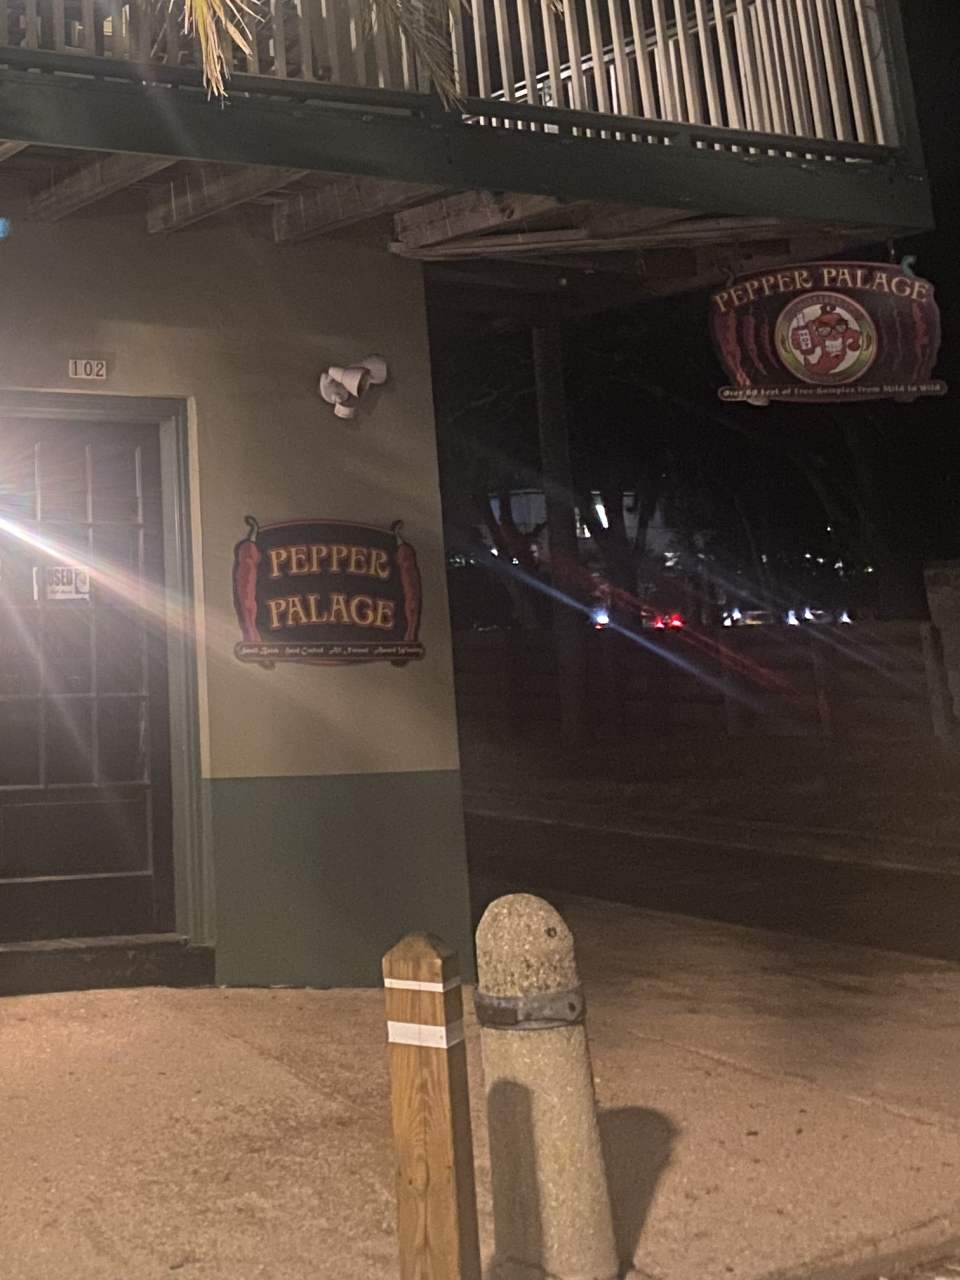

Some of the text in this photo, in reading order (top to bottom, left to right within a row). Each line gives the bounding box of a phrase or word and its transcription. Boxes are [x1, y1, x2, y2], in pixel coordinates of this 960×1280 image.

[714, 270, 813, 312] PEPPER
[72, 360, 105, 378] 102
[269, 545, 390, 578] PEPPER
